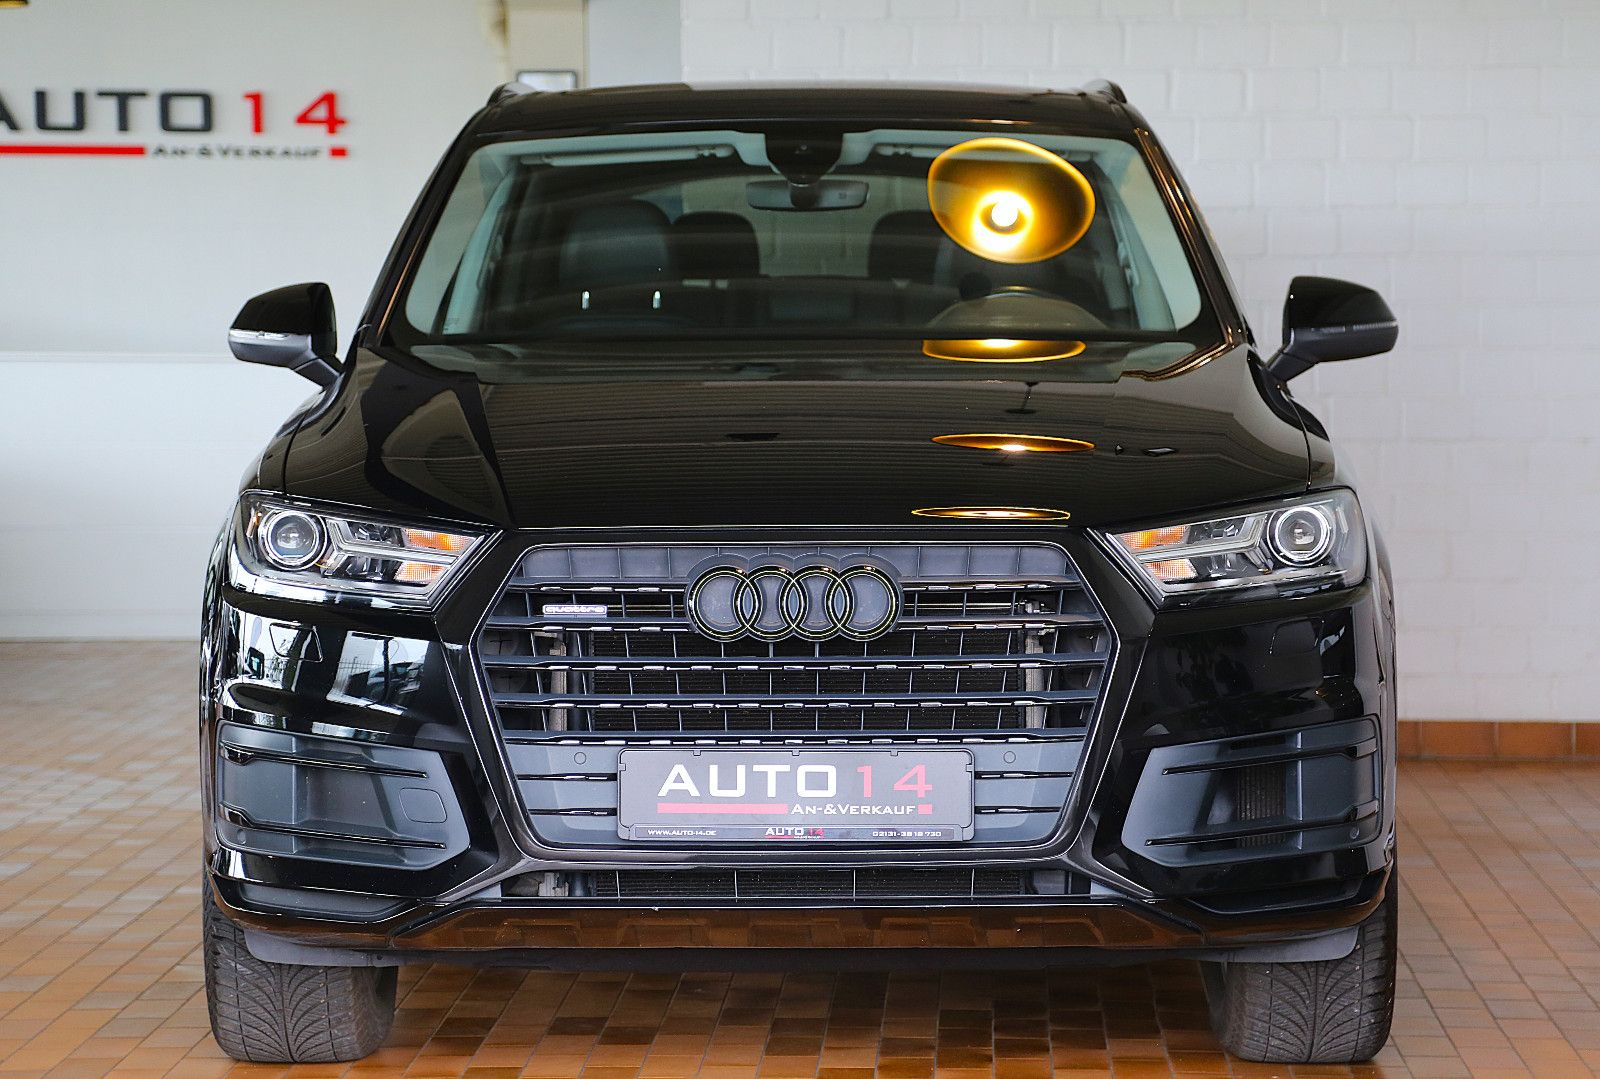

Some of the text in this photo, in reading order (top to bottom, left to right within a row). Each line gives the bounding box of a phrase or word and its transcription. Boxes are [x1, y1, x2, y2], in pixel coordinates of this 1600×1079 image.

[243, 91, 347, 134] 14
[657, 764, 933, 798] AUTO 14
[765, 827, 824, 836] AUTO 14
